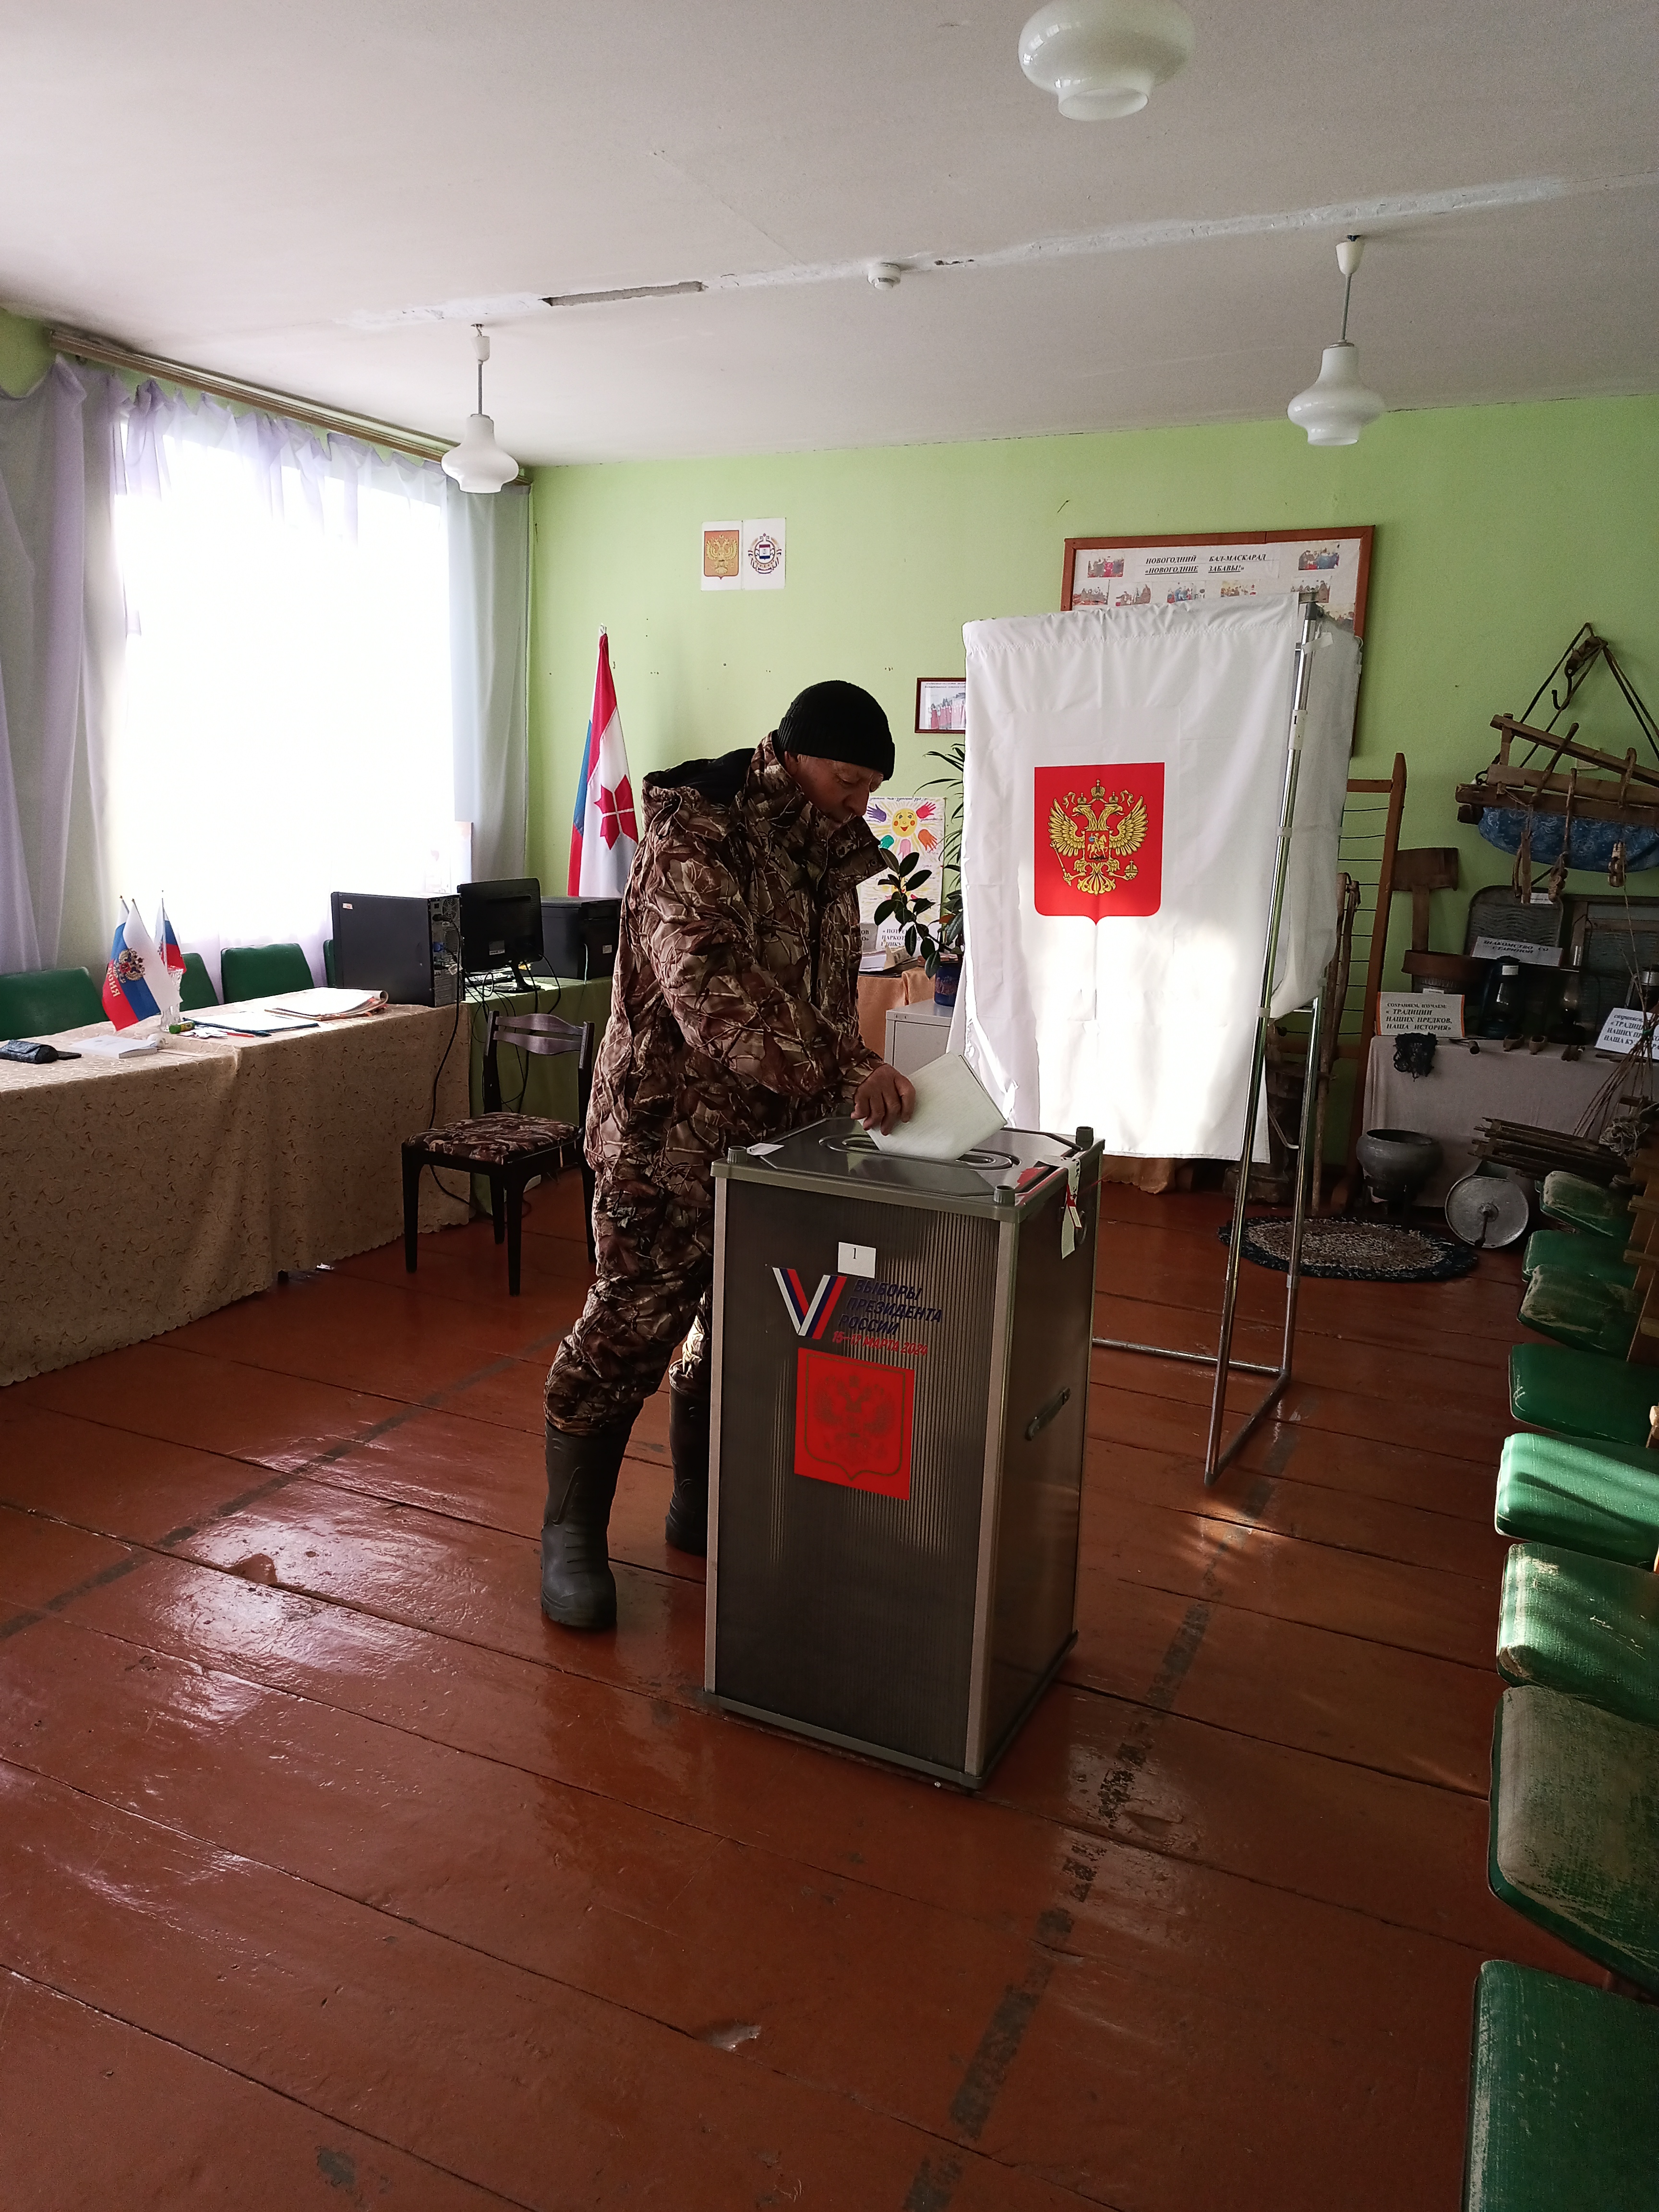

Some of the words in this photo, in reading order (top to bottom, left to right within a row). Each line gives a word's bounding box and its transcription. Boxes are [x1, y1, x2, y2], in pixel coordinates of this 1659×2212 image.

[1146, 555, 1197, 564] НОВОГОДНИЙ
[1209, 554, 1267, 562] БАЛ-МАСКАРАД
[1604, 1035, 1623, 1044] НАША
[853, 1248, 857, 1260] 1
[854, 1278, 923, 1300] ВЫБОРЫ
[846, 1297, 942, 1323] ПРЕЗИДЕНТА
[839, 1314, 900, 1335] РОССИИ
[862, 1336, 899, 1352] МАРТА
[901, 1342, 928, 1356] 2024
